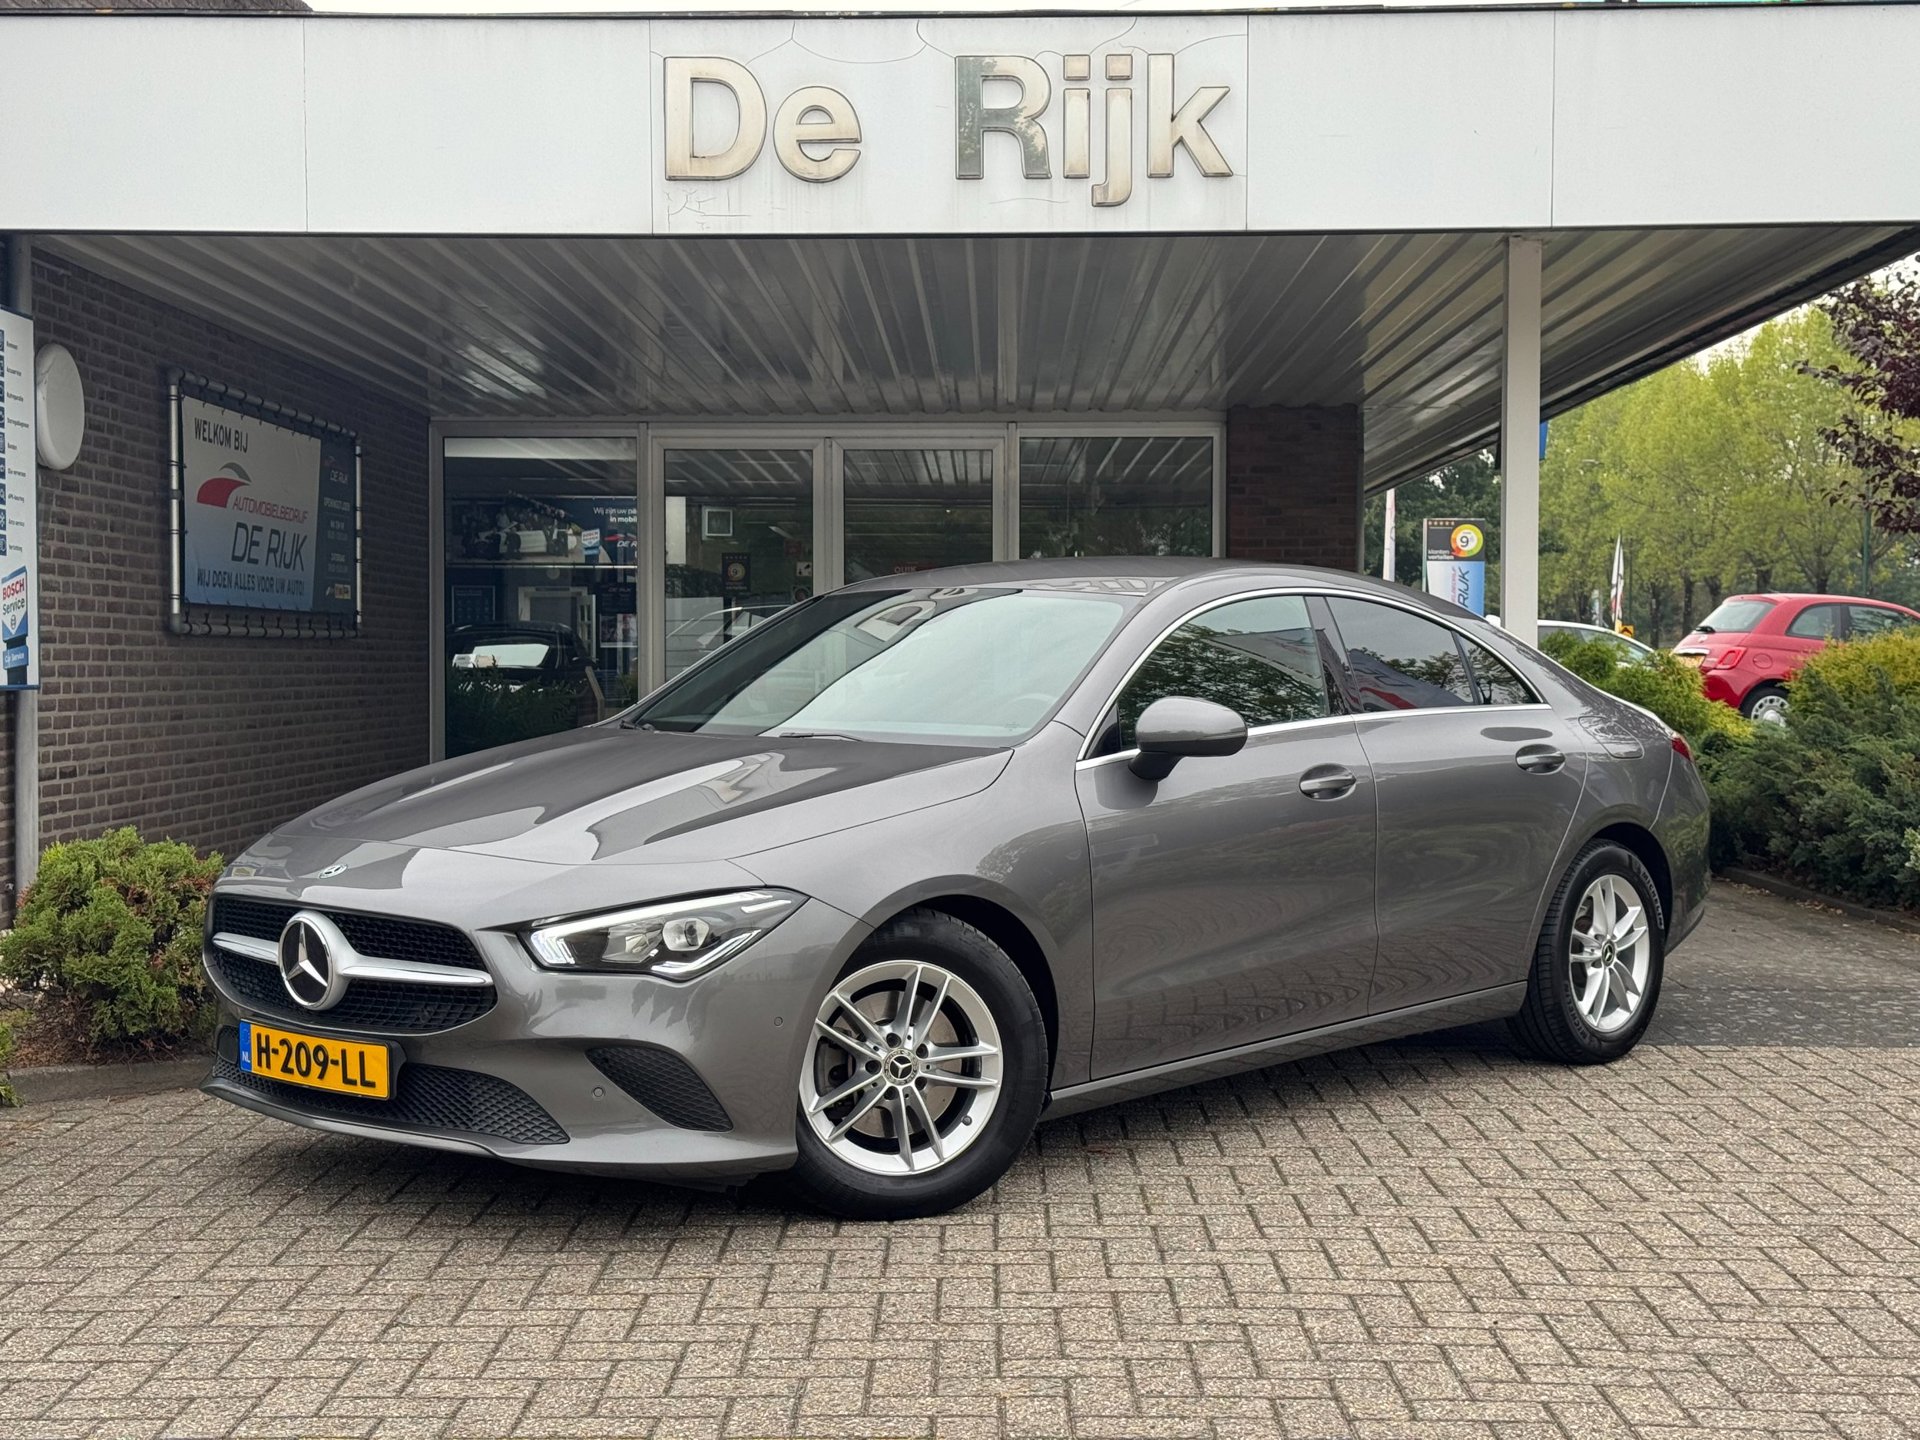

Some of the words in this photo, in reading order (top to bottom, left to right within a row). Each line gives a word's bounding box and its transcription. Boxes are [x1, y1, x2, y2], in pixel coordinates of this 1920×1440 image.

[664, 55, 863, 184] De
[954, 52, 1234, 208] Rijk
[194, 417, 232, 450] WELKOM
[234, 431, 249, 454] BIJ
[232, 496, 308, 524] AUTOMOBIELBEDRIJF
[618, 515, 638, 523] mobil
[231, 521, 263, 565] DE
[265, 529, 308, 572] RIJK
[2, 578, 25, 601] BOSCH
[197, 567, 210, 589] WIJ
[212, 569, 232, 590] DOEN
[234, 572, 255, 592] ALLES
[257, 575, 275, 593] VOOR
[275, 578, 285, 594] UW
[1457, 566, 1470, 608] RIJK
[2, 597, 26, 615] Service
[241, 1051, 251, 1063] NL
[255, 1032, 376, 1088] H-209-LL
